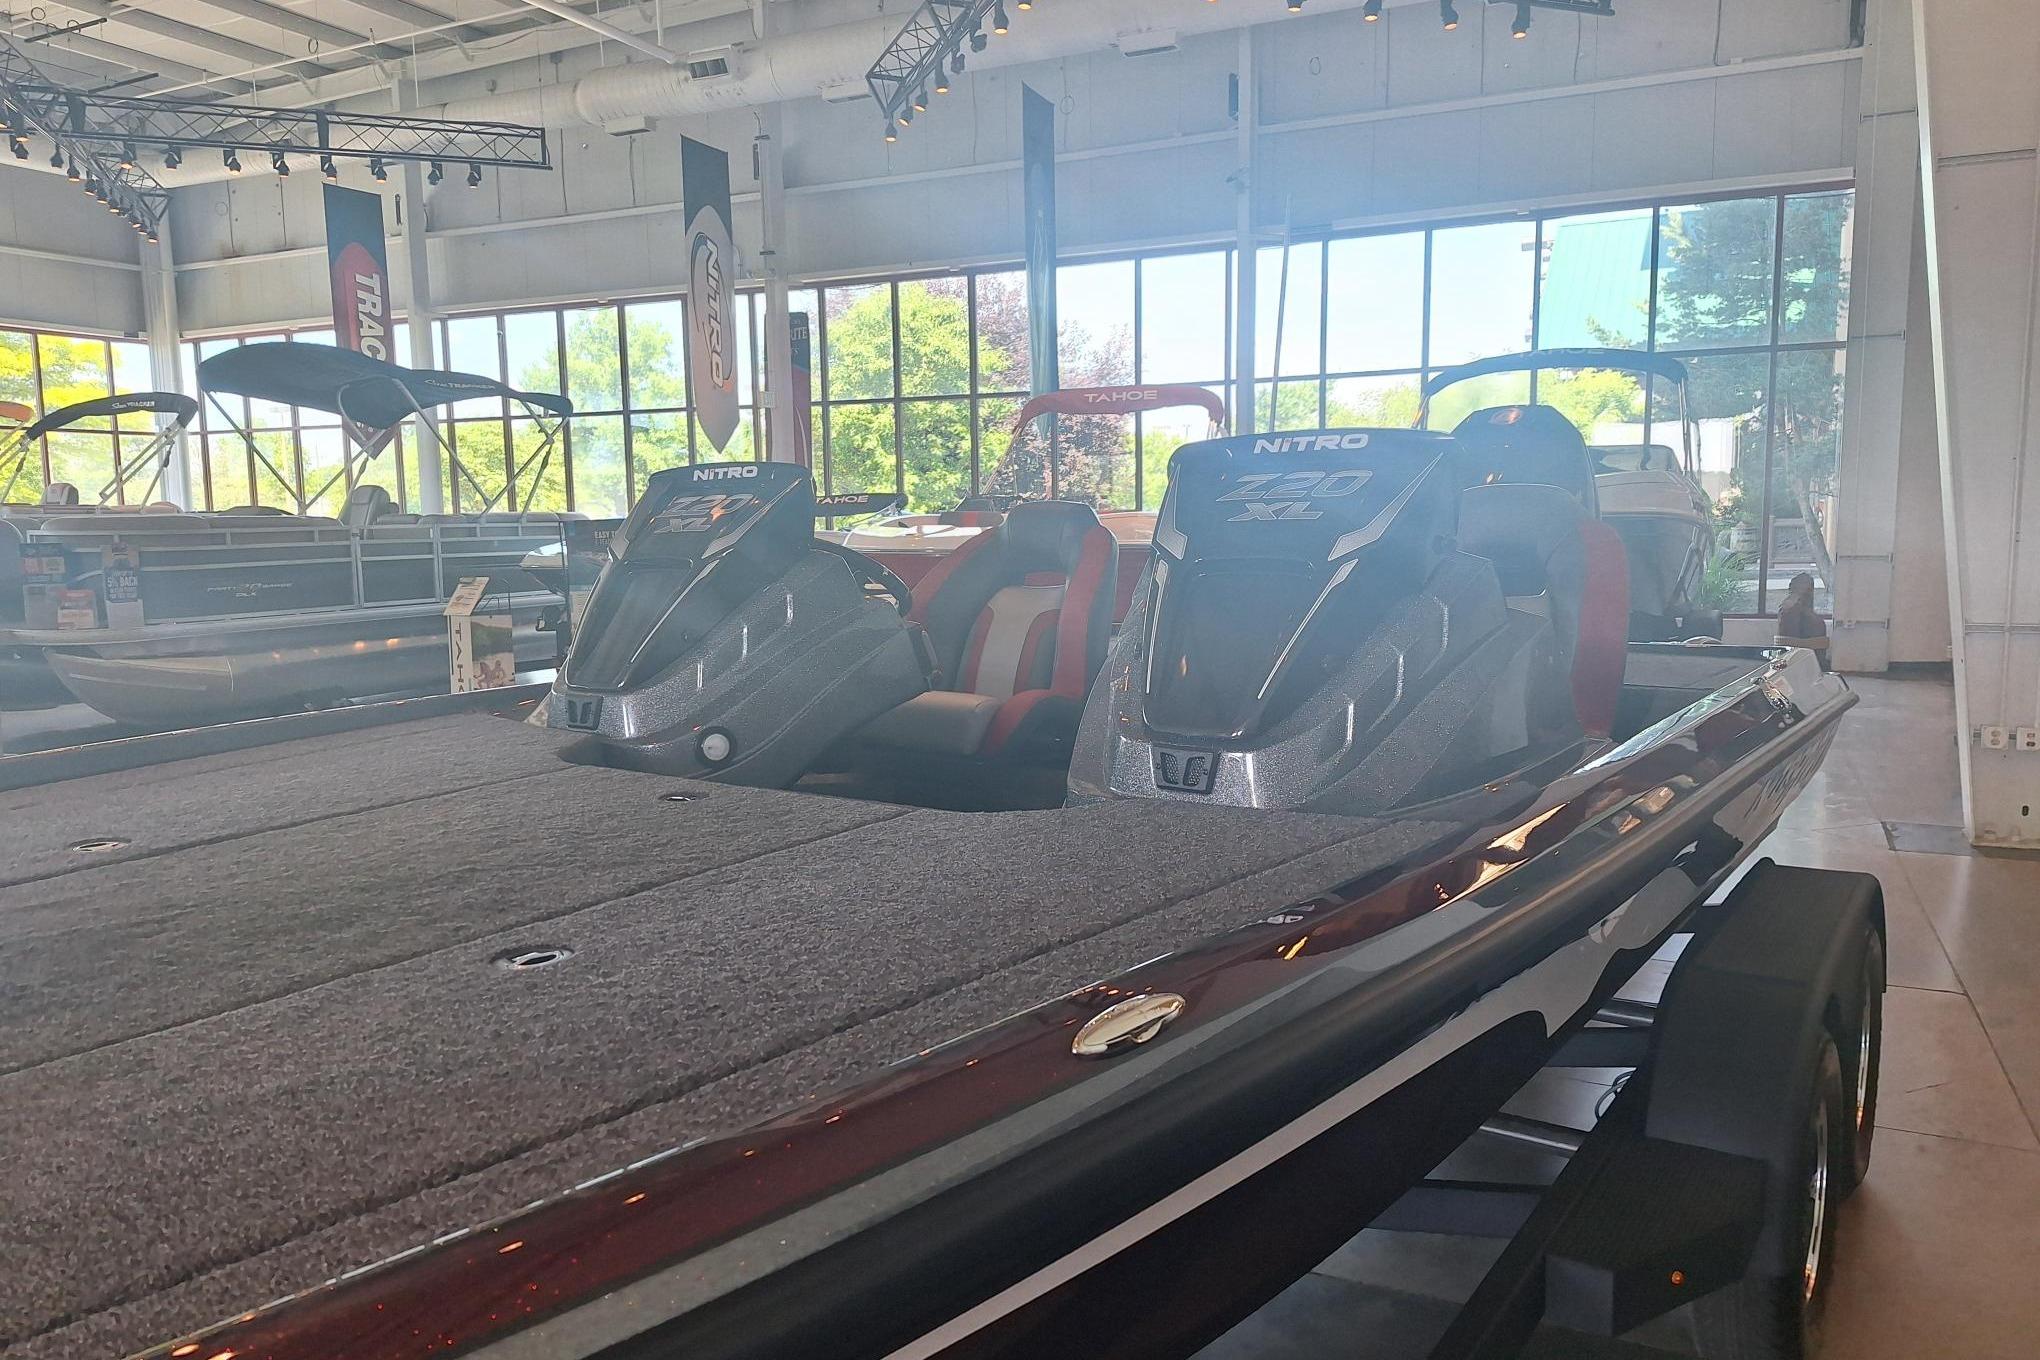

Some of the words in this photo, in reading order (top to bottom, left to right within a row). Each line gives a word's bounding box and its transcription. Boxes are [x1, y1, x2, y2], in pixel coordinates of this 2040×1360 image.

[354, 272, 387, 362] TRAC
[705, 238, 724, 388] NITRO
[1083, 390, 1158, 403] TAHOE
[1253, 433, 1369, 454] NITRO
[693, 466, 758, 481] NITRO
[1216, 470, 1374, 501] Z20
[1226, 501, 1324, 522] XL
